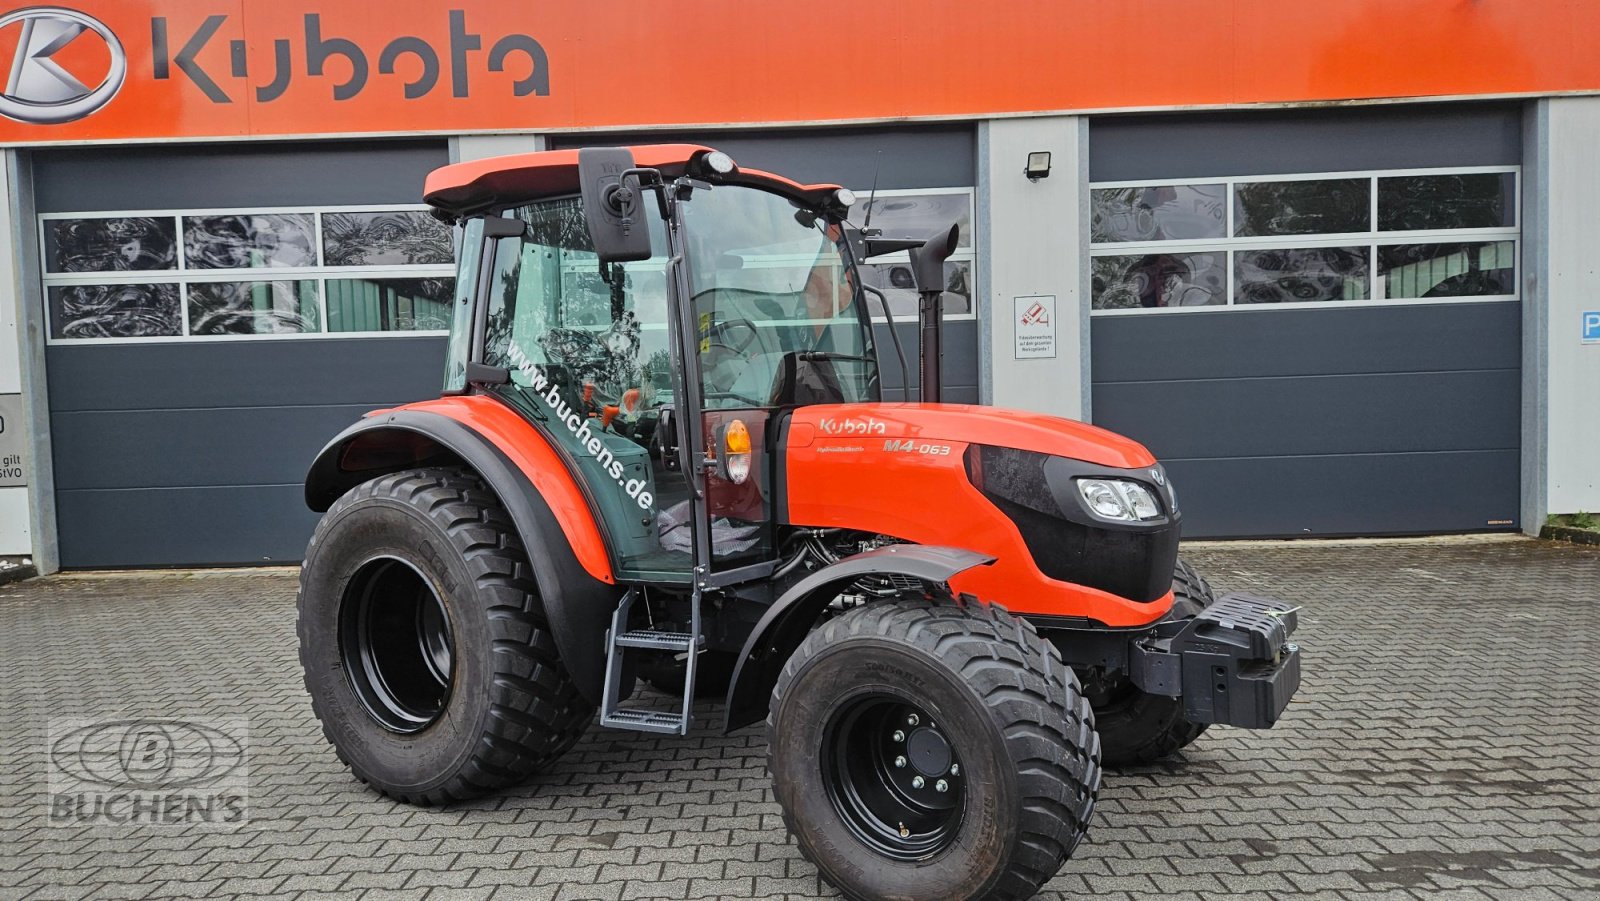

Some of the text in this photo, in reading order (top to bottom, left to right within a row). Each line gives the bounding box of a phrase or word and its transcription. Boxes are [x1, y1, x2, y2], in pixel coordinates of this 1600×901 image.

[152, 9, 550, 104] Kubota
[1585, 314, 1600, 337] P
[507, 339, 653, 509] www.buchens.de
[819, 418, 886, 434] Kubota
[882, 439, 951, 456] M4-063
[3, 455, 21, 467] gilt
